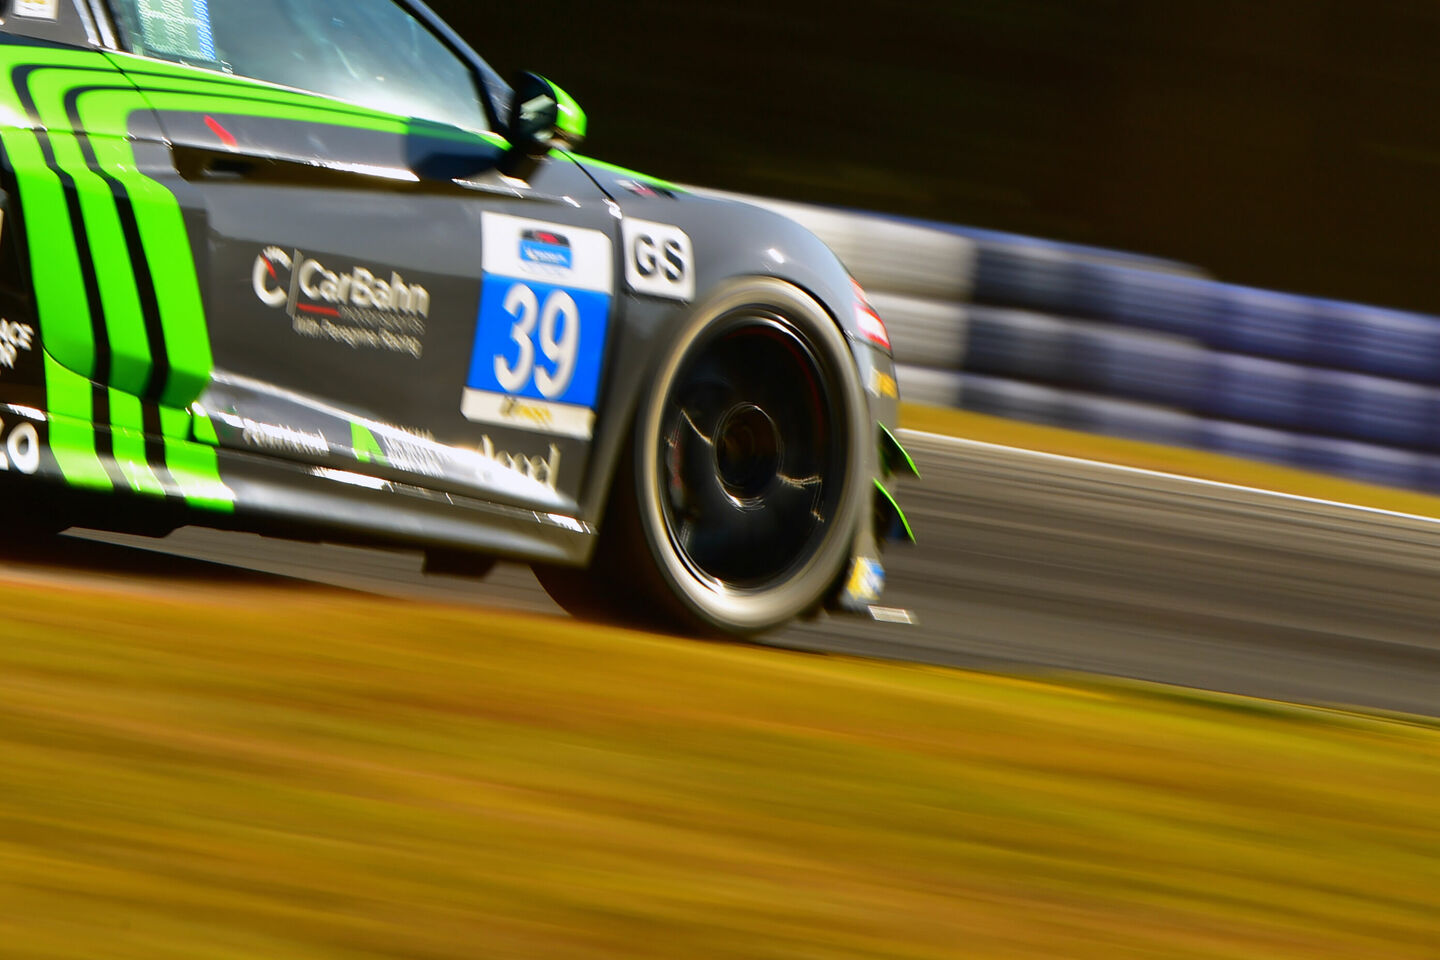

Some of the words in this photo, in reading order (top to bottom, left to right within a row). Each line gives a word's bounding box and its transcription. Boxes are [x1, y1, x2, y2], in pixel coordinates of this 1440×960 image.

[298, 258, 430, 318] CarBahn
[634, 234, 684, 283] GS
[494, 283, 580, 399] 39
